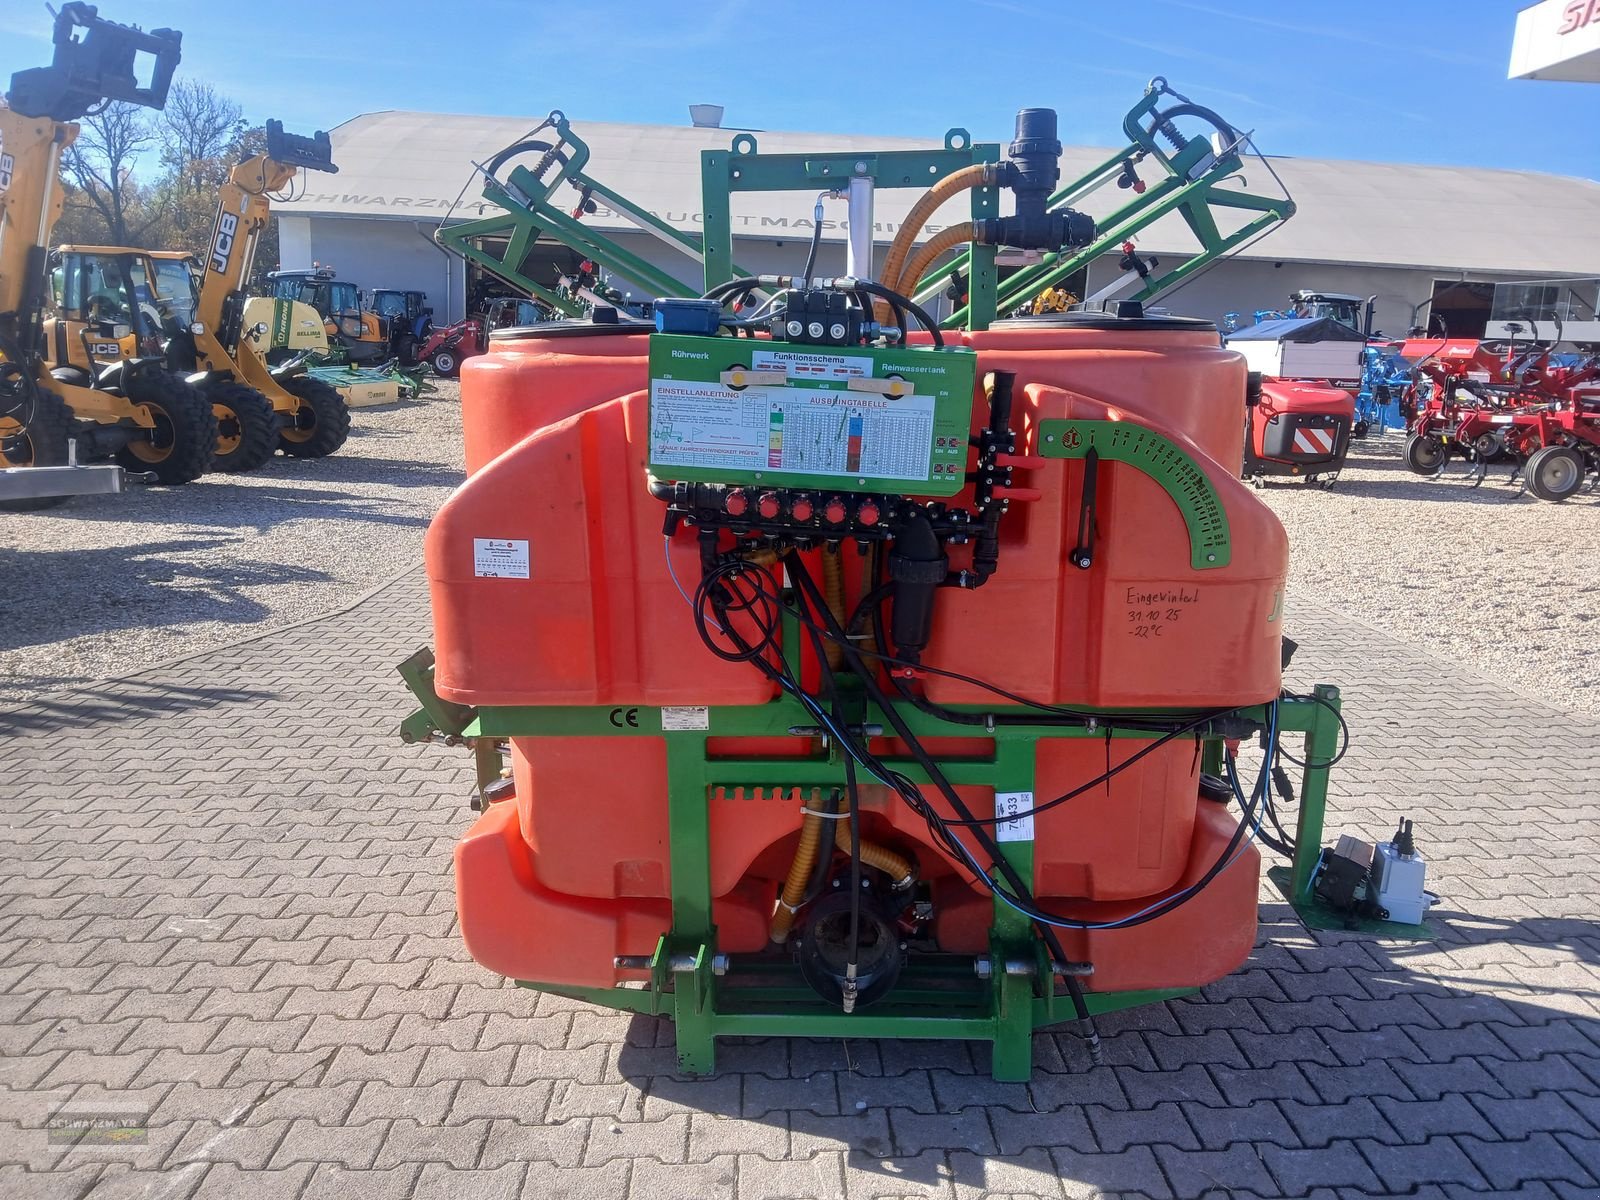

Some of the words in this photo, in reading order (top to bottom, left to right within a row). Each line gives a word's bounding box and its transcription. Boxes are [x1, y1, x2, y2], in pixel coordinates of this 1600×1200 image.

[212, 212, 237, 273] JCB
[671, 349, 710, 360] Rührwerk
[773, 352, 845, 364] Funktionsschema
[882, 363, 946, 375] Reinwassertank
[657, 387, 740, 399] EINSTELLANLEITUNG
